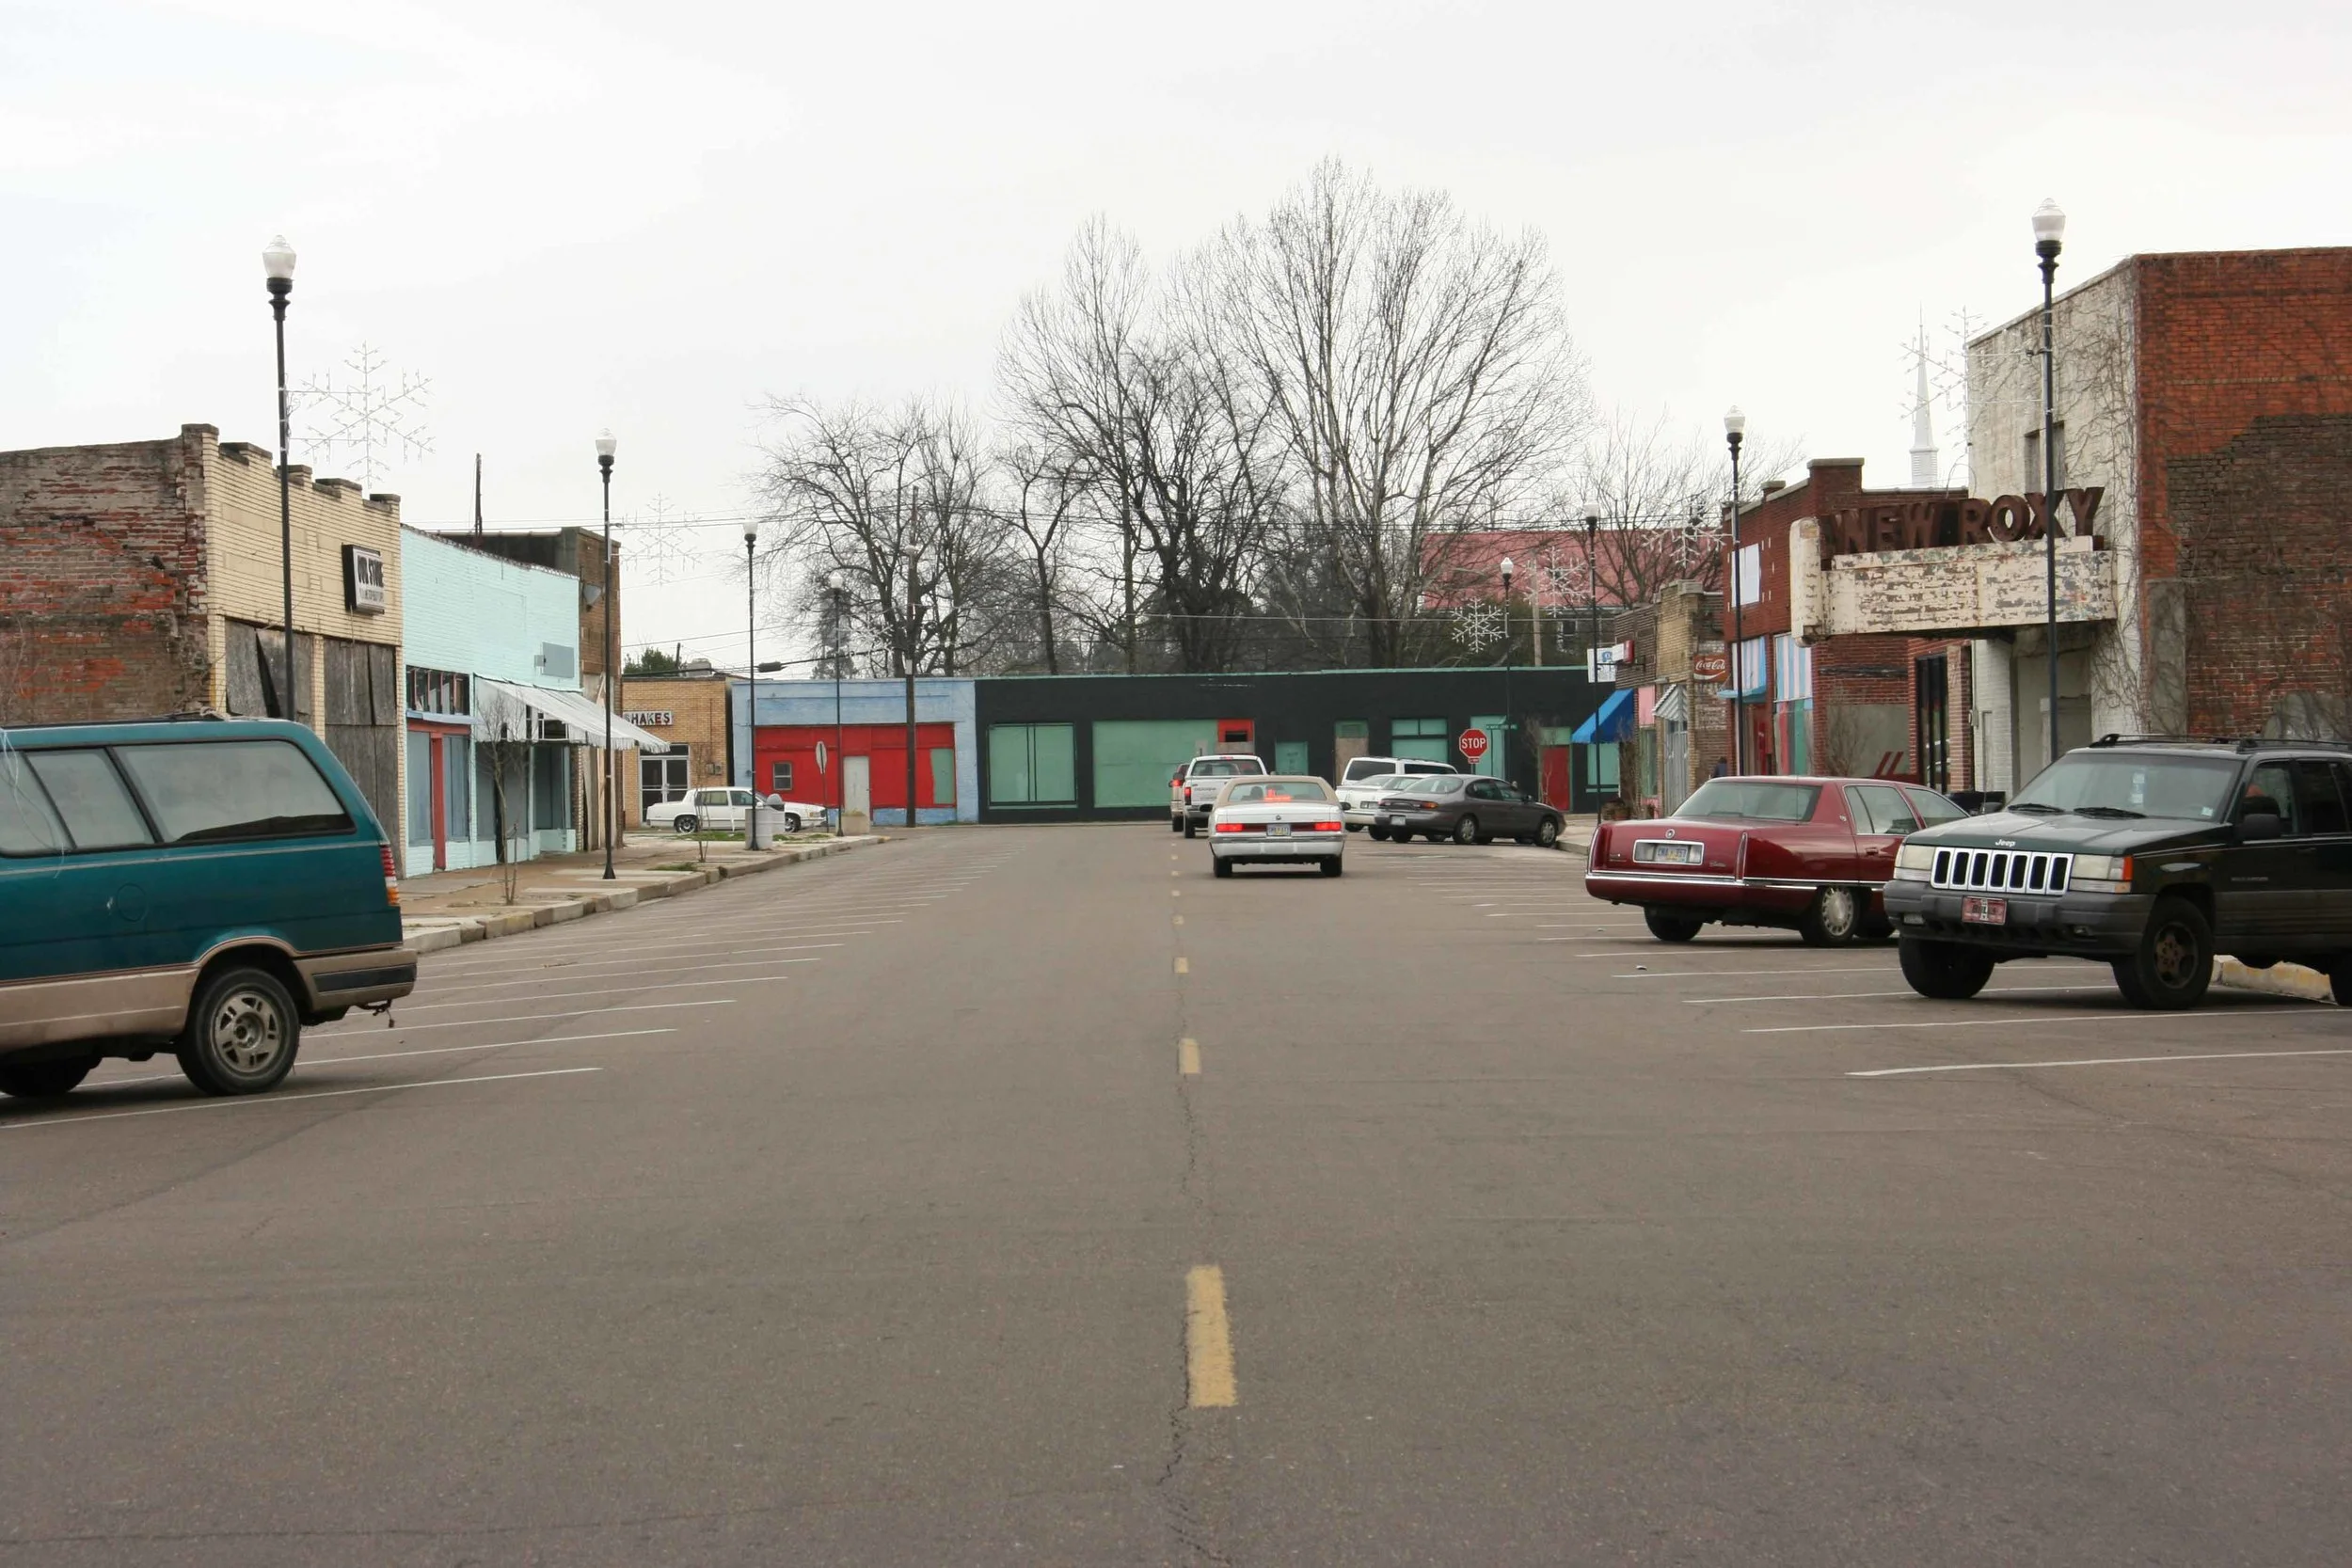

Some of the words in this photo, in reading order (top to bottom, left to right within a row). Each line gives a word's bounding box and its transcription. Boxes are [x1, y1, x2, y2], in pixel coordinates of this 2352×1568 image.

[1835, 500, 1939, 552] NEW
[1958, 487, 2105, 545] ROXY
[625, 712, 670, 724] SHAKES
[1461, 737, 1486, 749] STOP
[1994, 839, 2016, 847] Jeep
